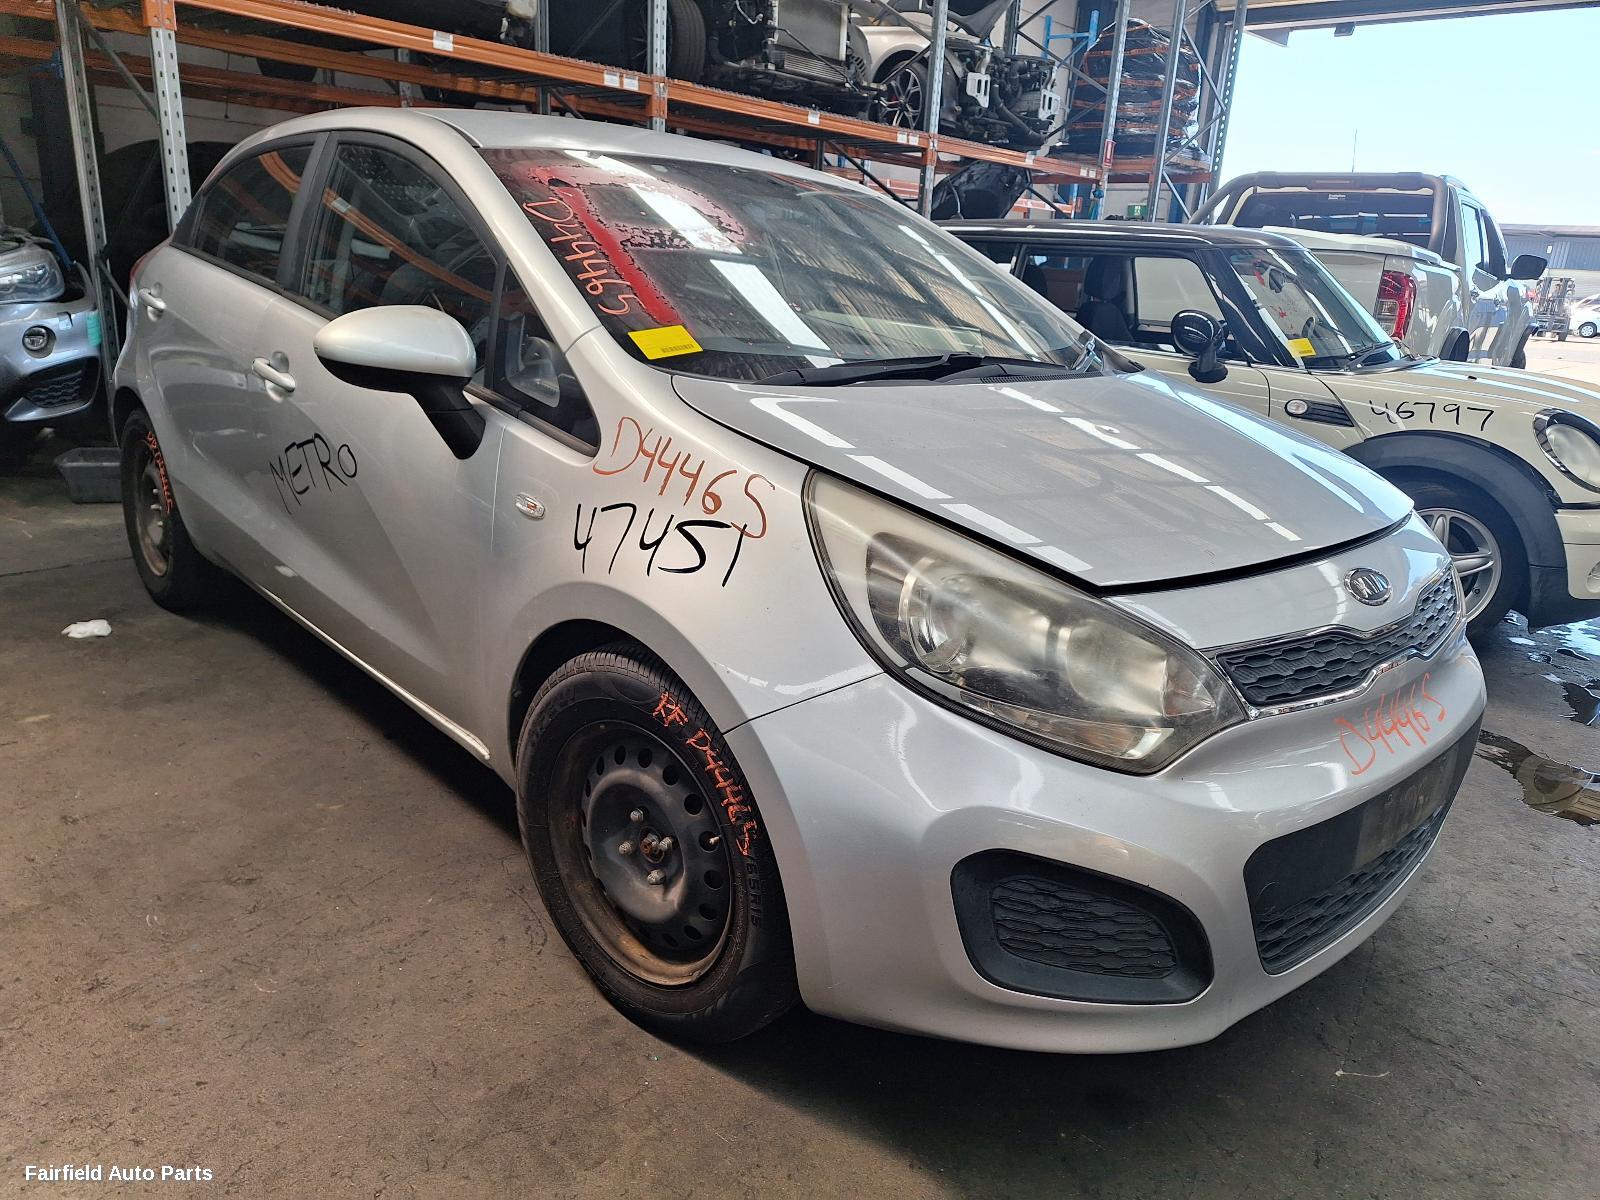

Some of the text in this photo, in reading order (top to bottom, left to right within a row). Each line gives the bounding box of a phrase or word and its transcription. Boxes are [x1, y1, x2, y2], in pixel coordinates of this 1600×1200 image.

[1368, 399, 1495, 432] 46797
[268, 432, 358, 515] METRO
[573, 502, 748, 588] 47451
